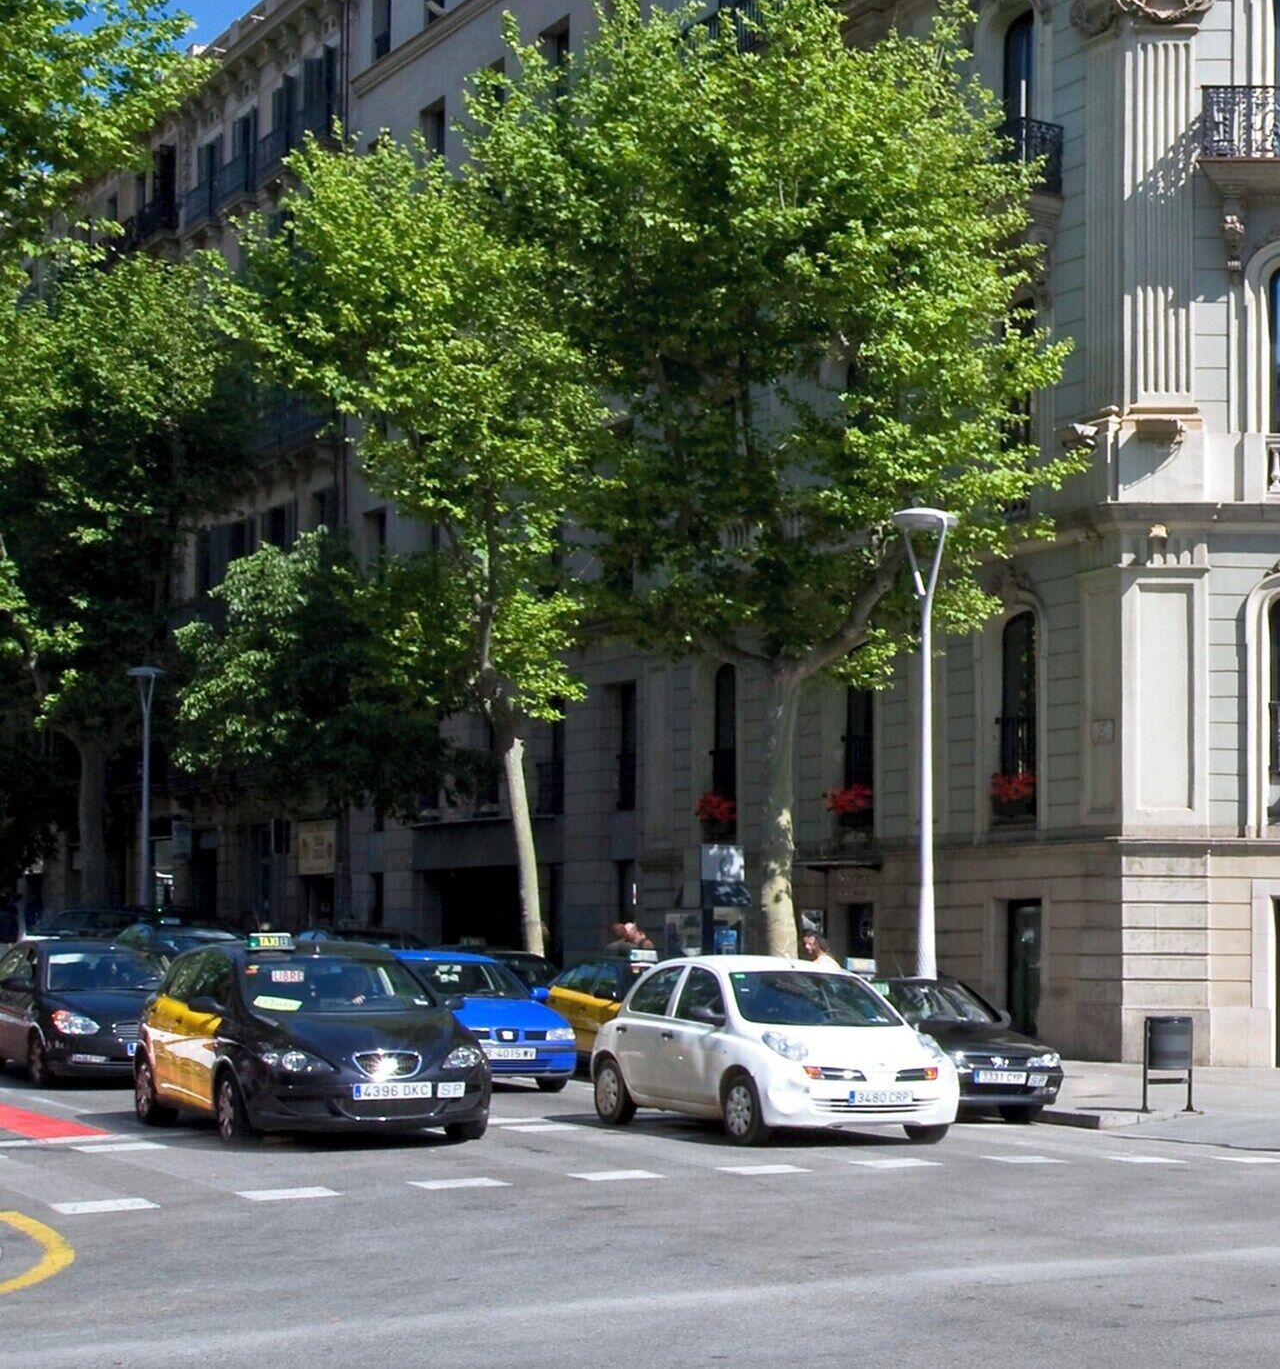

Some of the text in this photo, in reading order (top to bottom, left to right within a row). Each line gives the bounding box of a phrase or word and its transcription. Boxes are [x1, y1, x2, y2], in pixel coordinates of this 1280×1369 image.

[260, 937, 278, 946] TAXI
[274, 971, 304, 981] LIBRE
[363, 1084, 429, 1097] 4396 DKC
[441, 1084, 462, 1096] SP
[857, 1091, 909, 1104] 3480 CRP
